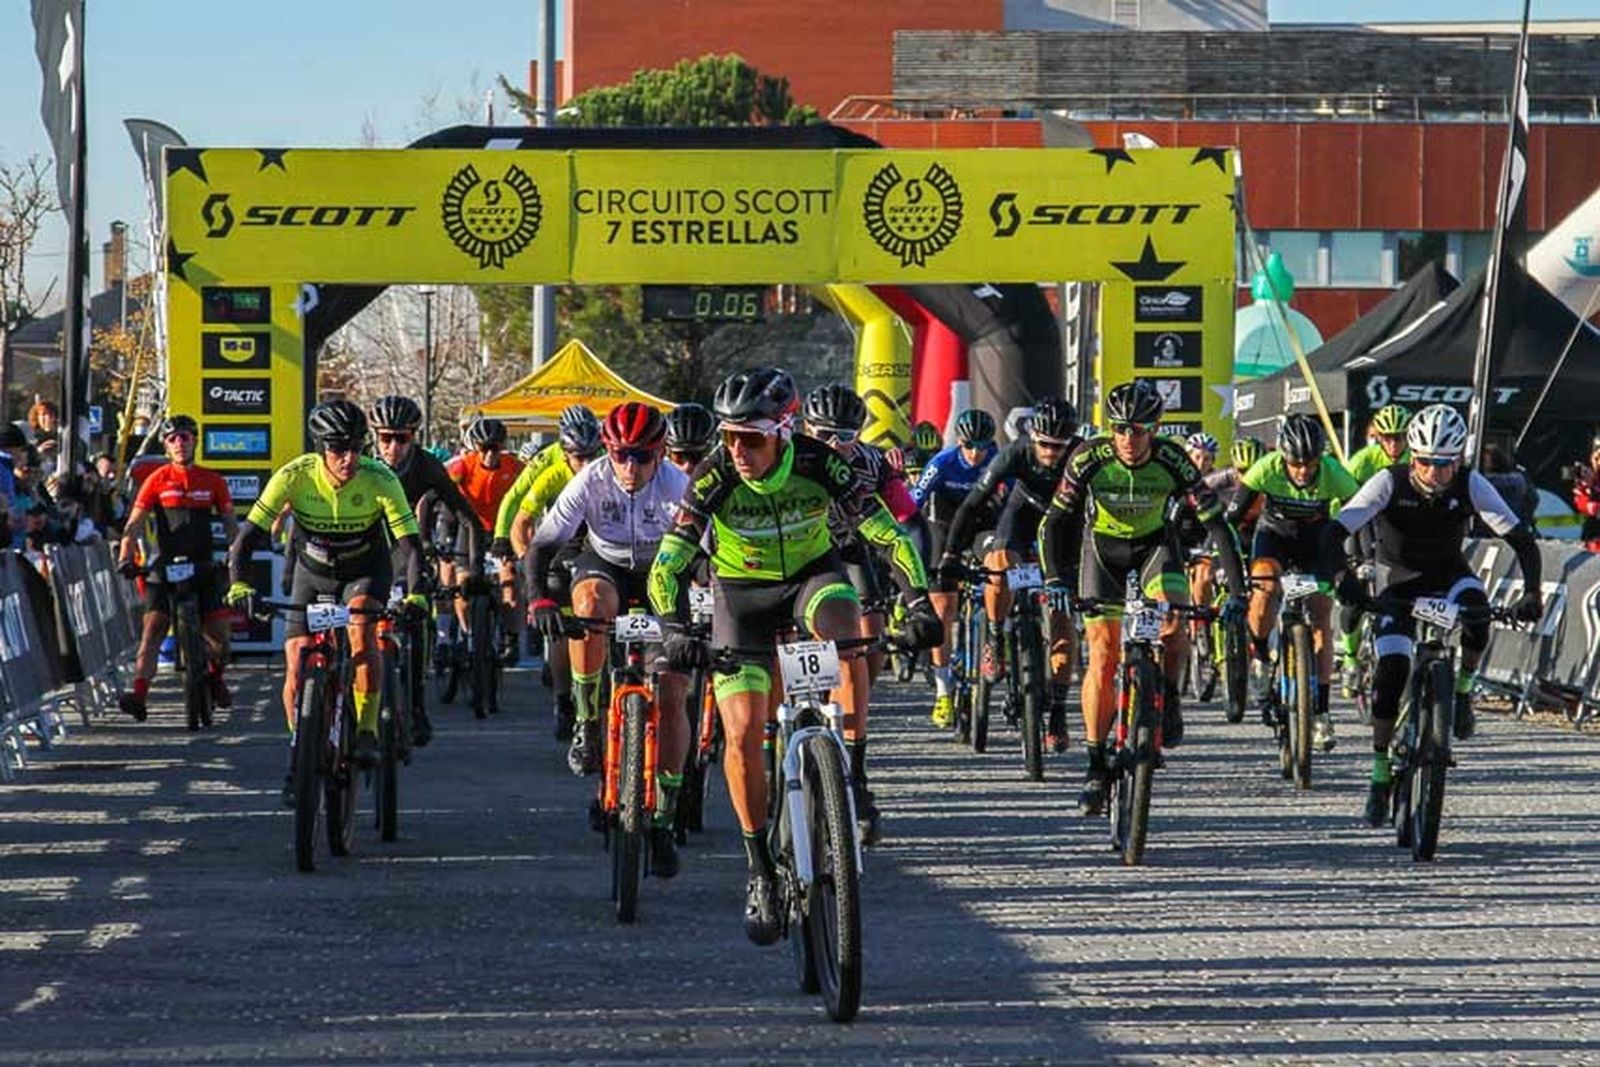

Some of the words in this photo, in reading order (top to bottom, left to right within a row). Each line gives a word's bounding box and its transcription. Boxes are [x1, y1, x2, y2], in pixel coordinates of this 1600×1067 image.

[573, 189, 725, 214] CIRCUITO
[734, 189, 833, 214] SCOTT
[240, 205, 417, 226] SCOTT
[1026, 203, 1202, 225] SCOTT
[606, 220, 622, 244] 7
[631, 220, 799, 244] ESTRELLAS
[695, 292, 757, 316] 0.06
[223, 389, 265, 402] TACTIC
[1392, 385, 1519, 404] SCOT
[629, 616, 651, 629] 25
[798, 653, 821, 676] 18
